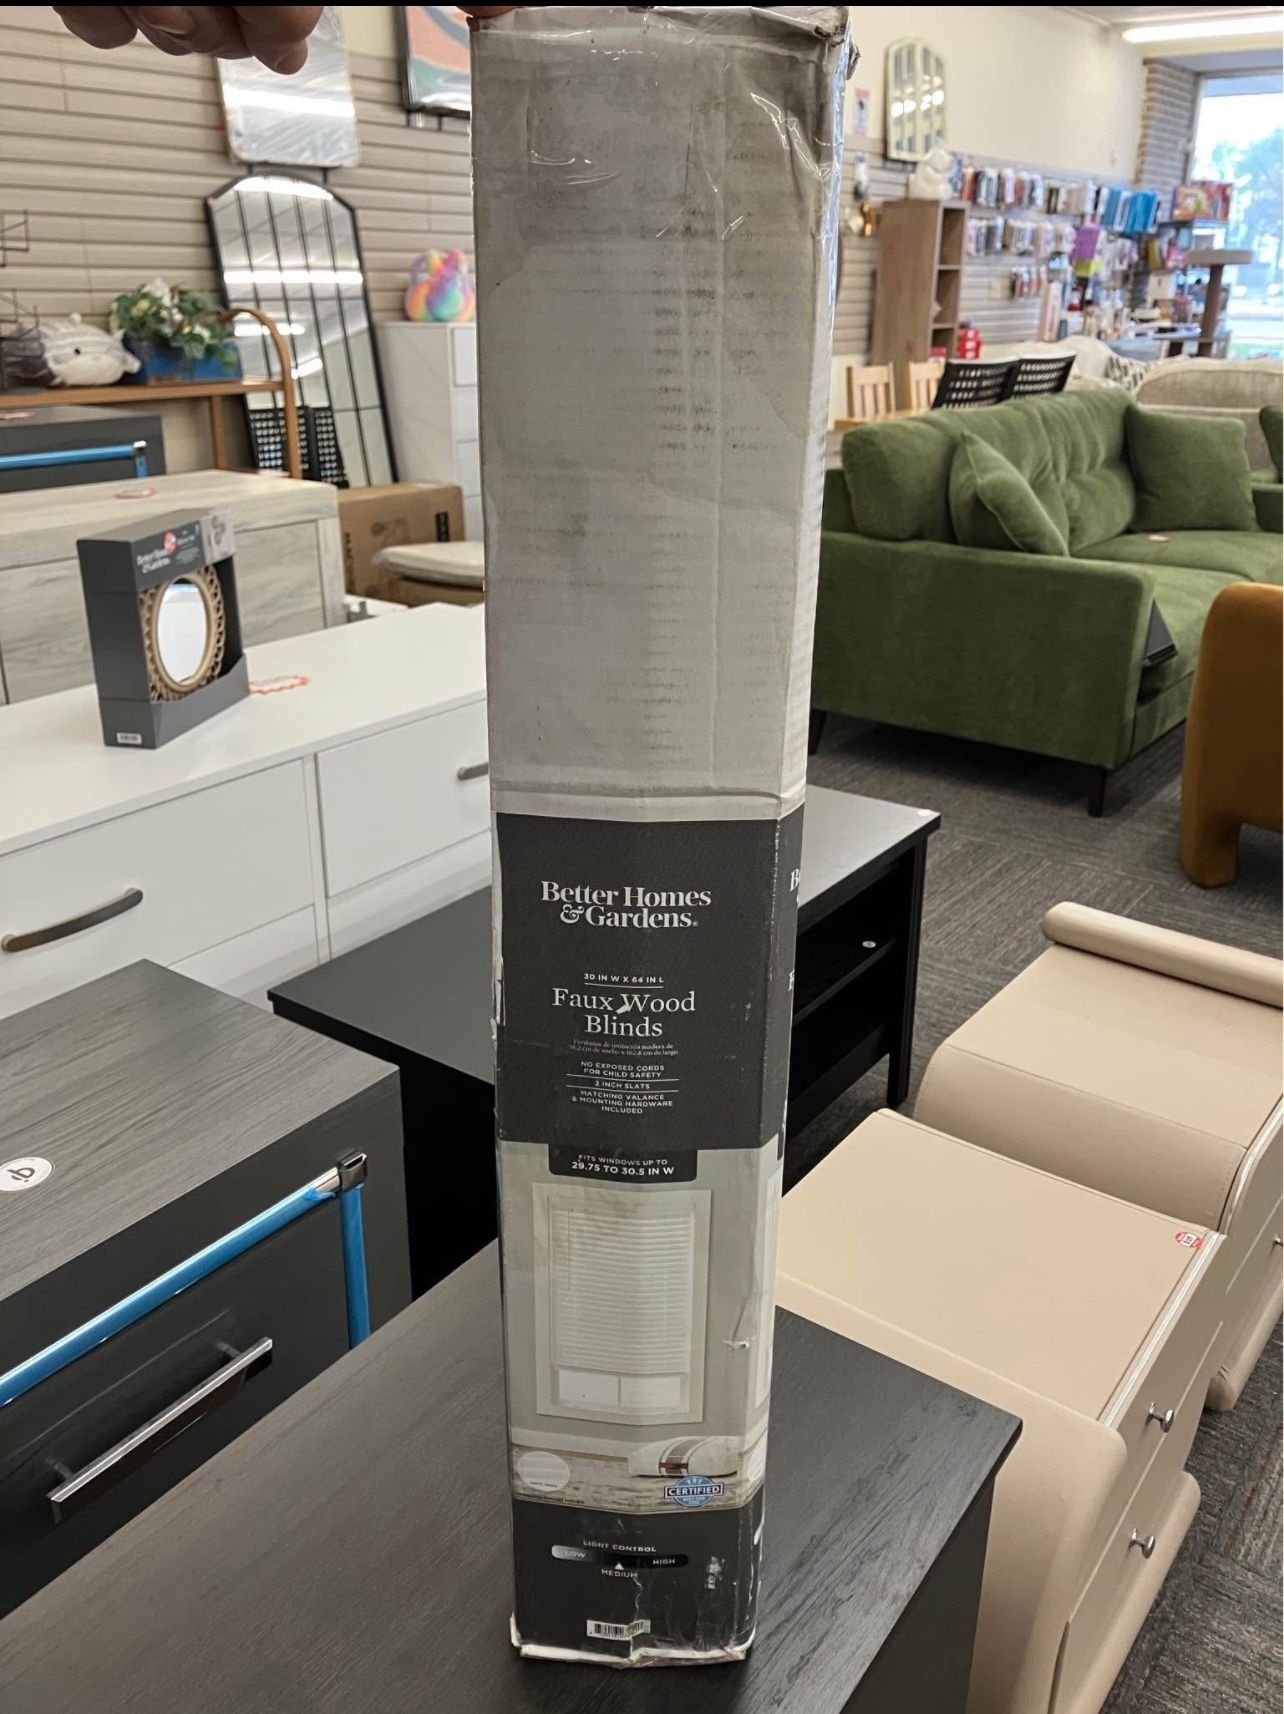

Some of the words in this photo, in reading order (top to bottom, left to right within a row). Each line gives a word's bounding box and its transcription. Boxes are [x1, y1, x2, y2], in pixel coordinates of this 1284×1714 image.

[541, 880, 619, 905] Better
[623, 886, 712, 907] Homes
[552, 987, 614, 1011] Faux
[620, 990, 696, 1013] Wood
[584, 1014, 663, 1037] Blinds
[595, 1062, 634, 1071] EXPOSED
[603, 1070, 628, 1078] CHILD
[602, 1081, 622, 1089] INCH
[580, 1090, 623, 1100] MATCHING
[580, 1096, 623, 1106] MOUNTING
[601, 1105, 643, 1114] INCLUDED
[598, 1157, 641, 1166] WINDOWS
[571, 1161, 600, 1172] 29.75
[603, 1165, 619, 1174] TO
[621, 1167, 645, 1176] 30.5
[648, 1167, 660, 1175] IN
[663, 1166, 675, 1175] W
[668, 1485, 720, 1496] CERTIFIED
[583, 1540, 609, 1549] LIGHT
[612, 1544, 657, 1552] CONTROL
[564, 1550, 586, 1558] LOW
[601, 1568, 638, 1578] MEDIUM
